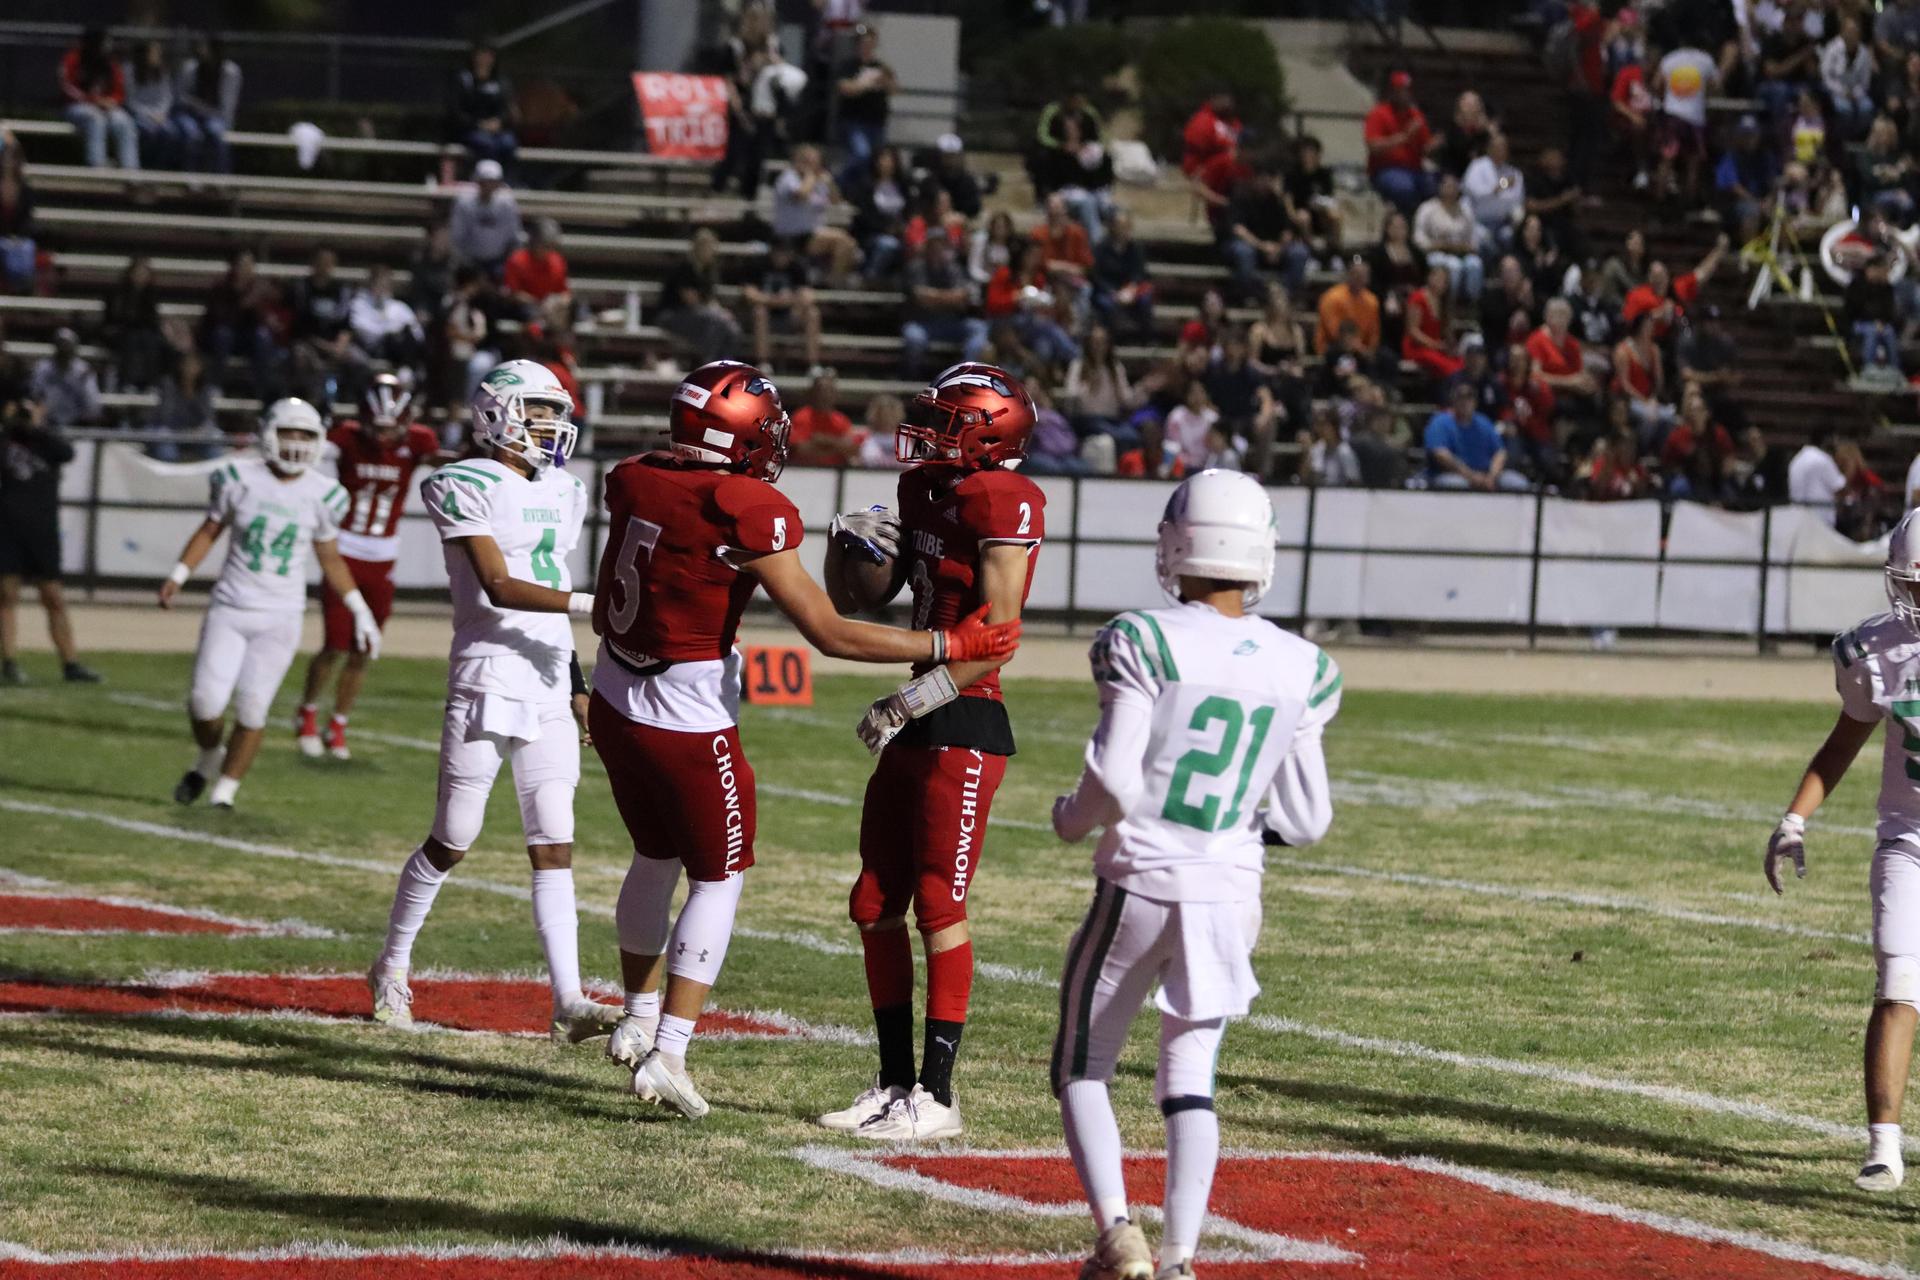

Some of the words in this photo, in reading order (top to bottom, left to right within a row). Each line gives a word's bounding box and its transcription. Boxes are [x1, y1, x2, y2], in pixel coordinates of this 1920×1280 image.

[351, 481, 399, 535] 11
[442, 491, 465, 521] 4
[522, 508, 562, 523] RIVERDALE
[1016, 501, 1031, 535] 2
[240, 515, 298, 577] 44
[771, 517, 787, 551] 5
[912, 529, 946, 560] TRIBE
[531, 528, 562, 591] 4
[608, 514, 663, 635] 5
[755, 651, 804, 695] 10
[1162, 695, 1276, 833] 21
